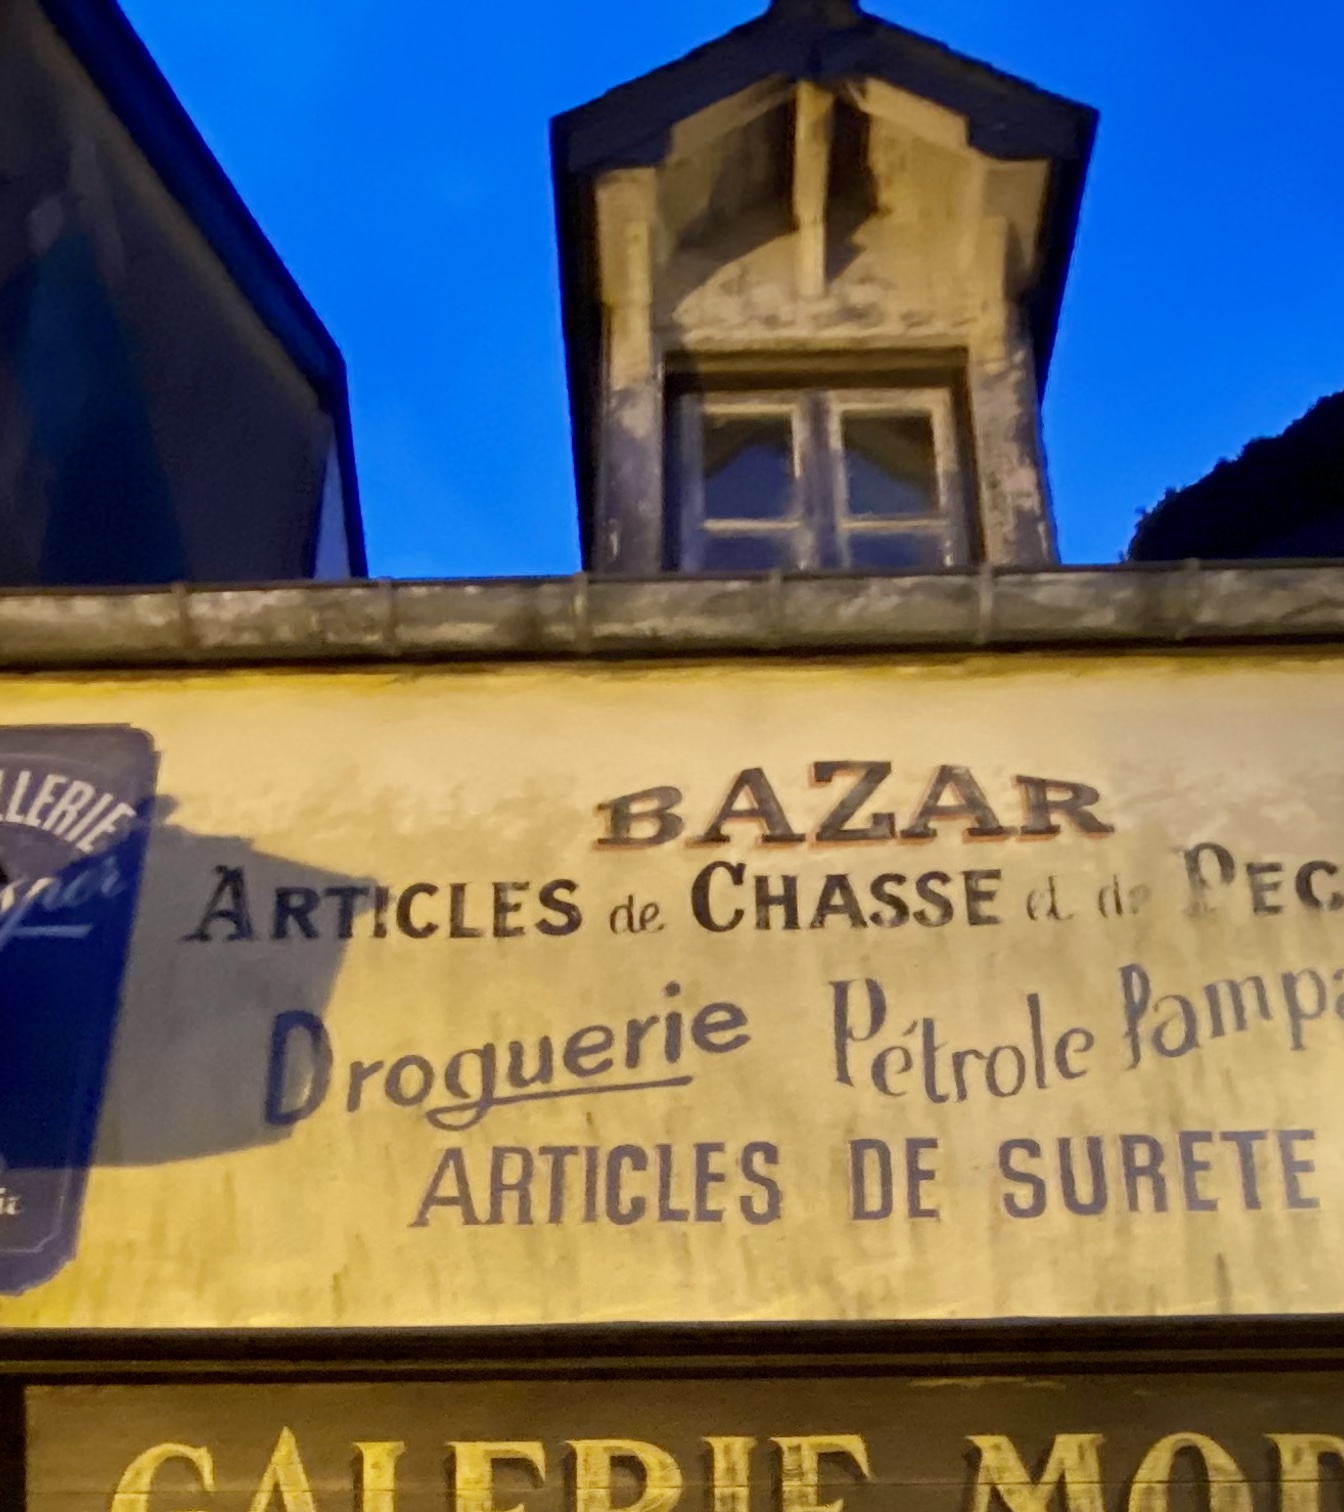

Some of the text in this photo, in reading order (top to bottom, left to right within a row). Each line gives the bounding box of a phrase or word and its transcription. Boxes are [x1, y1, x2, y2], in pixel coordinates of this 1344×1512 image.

[592, 760, 1115, 851] BAZAR
[181, 863, 582, 941] ARTICLES
[609, 894, 667, 935] de
[691, 861, 1003, 932] CHASSE
[265, 981, 749, 1131] Droguerie
[828, 977, 1094, 1102] Pétrole
[407, 1129, 1321, 1228] ARTICLES DE SURETE
